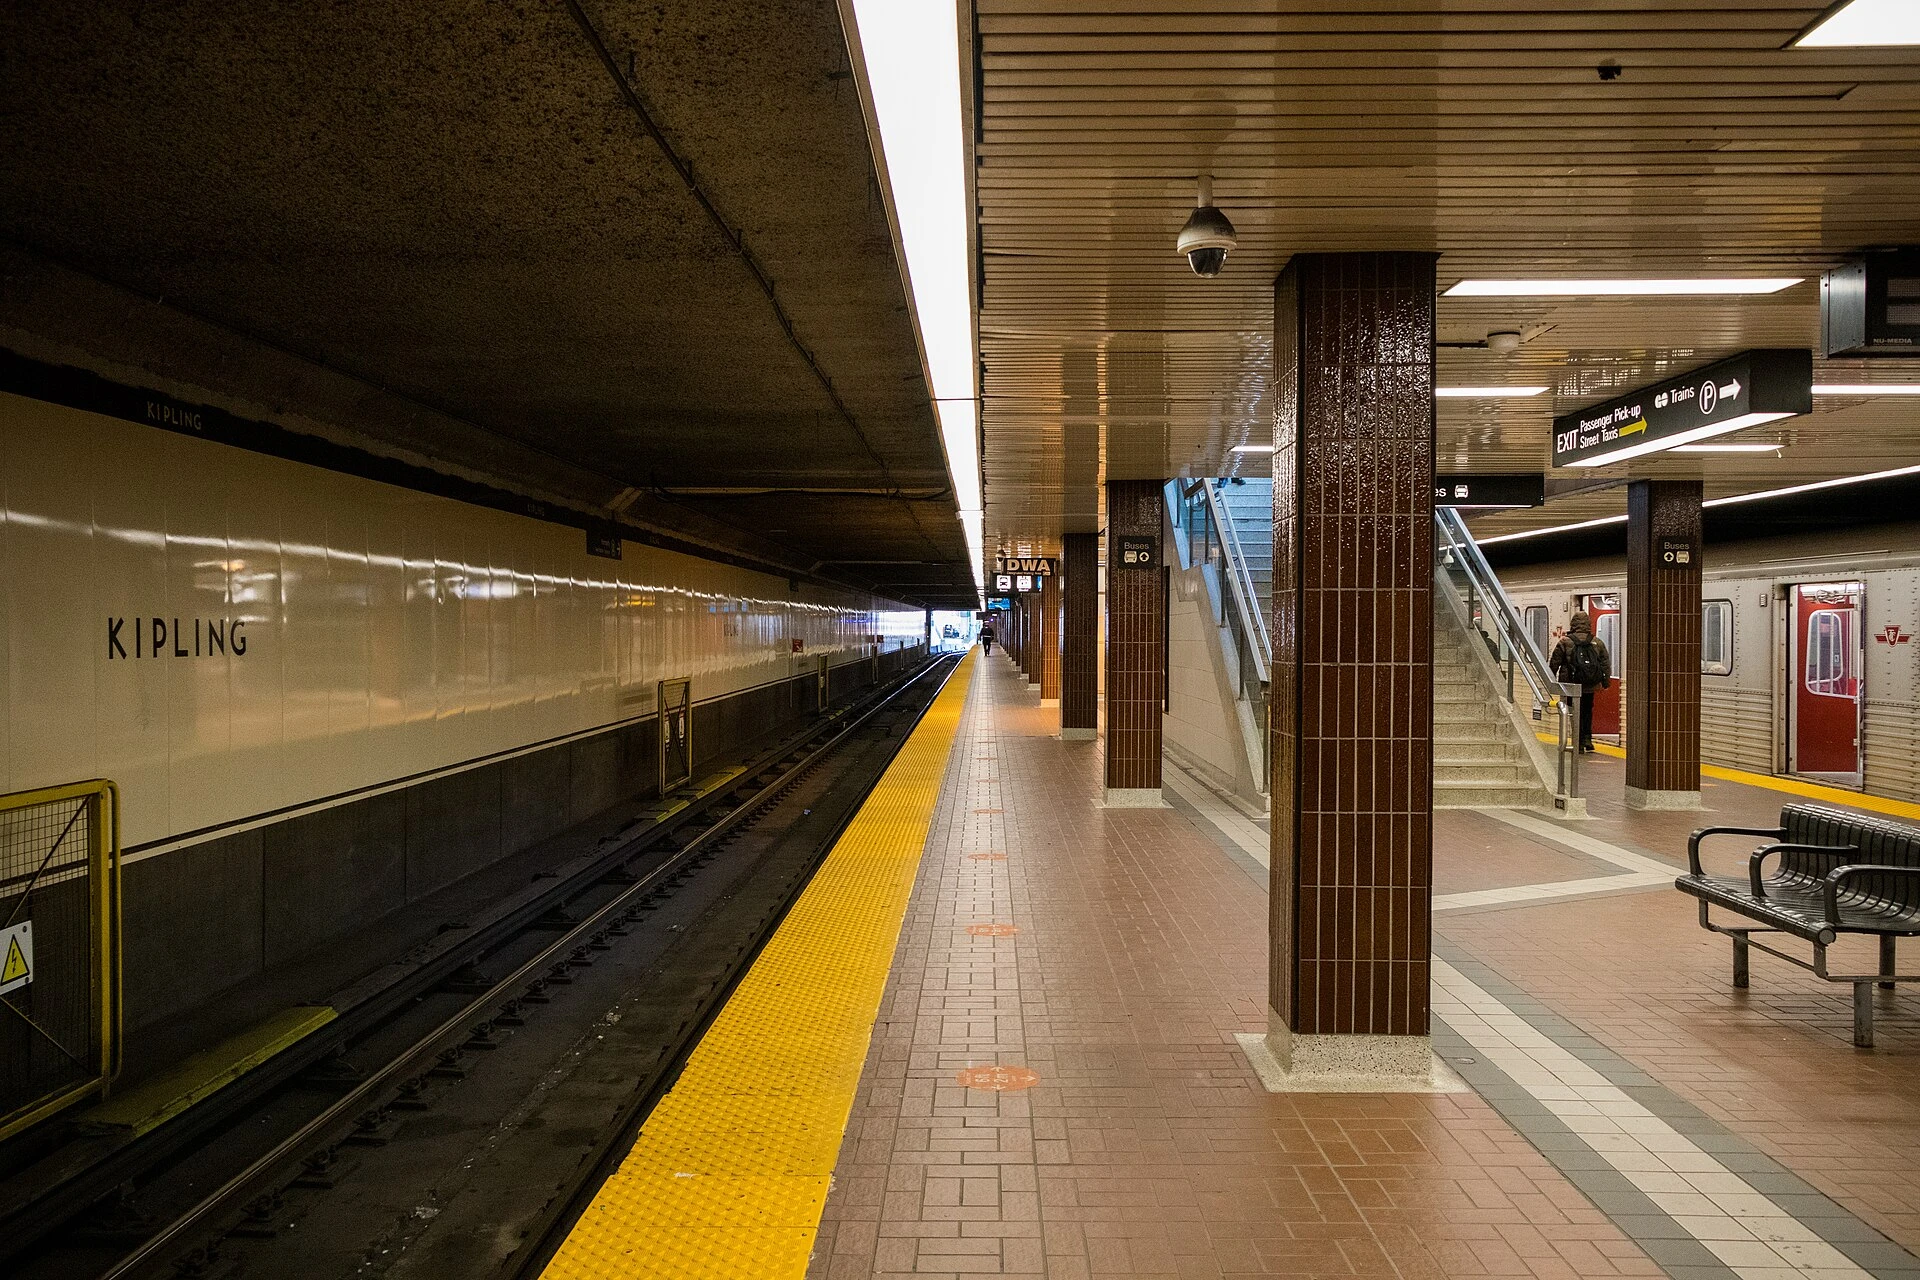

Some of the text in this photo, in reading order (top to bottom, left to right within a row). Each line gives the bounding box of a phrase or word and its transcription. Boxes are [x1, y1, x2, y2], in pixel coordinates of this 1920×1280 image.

[1670, 385, 1695, 404] Trains
[147, 401, 202, 431] KIPLING
[1580, 404, 1641, 434] Passenger Pick-up
[1557, 428, 1579, 454] EXIT
[1579, 427, 1618, 450] Street Taxis
[1124, 542, 1149, 550] Buses
[1006, 559, 1051, 571] DWA
[108, 617, 247, 660] KIPLING
